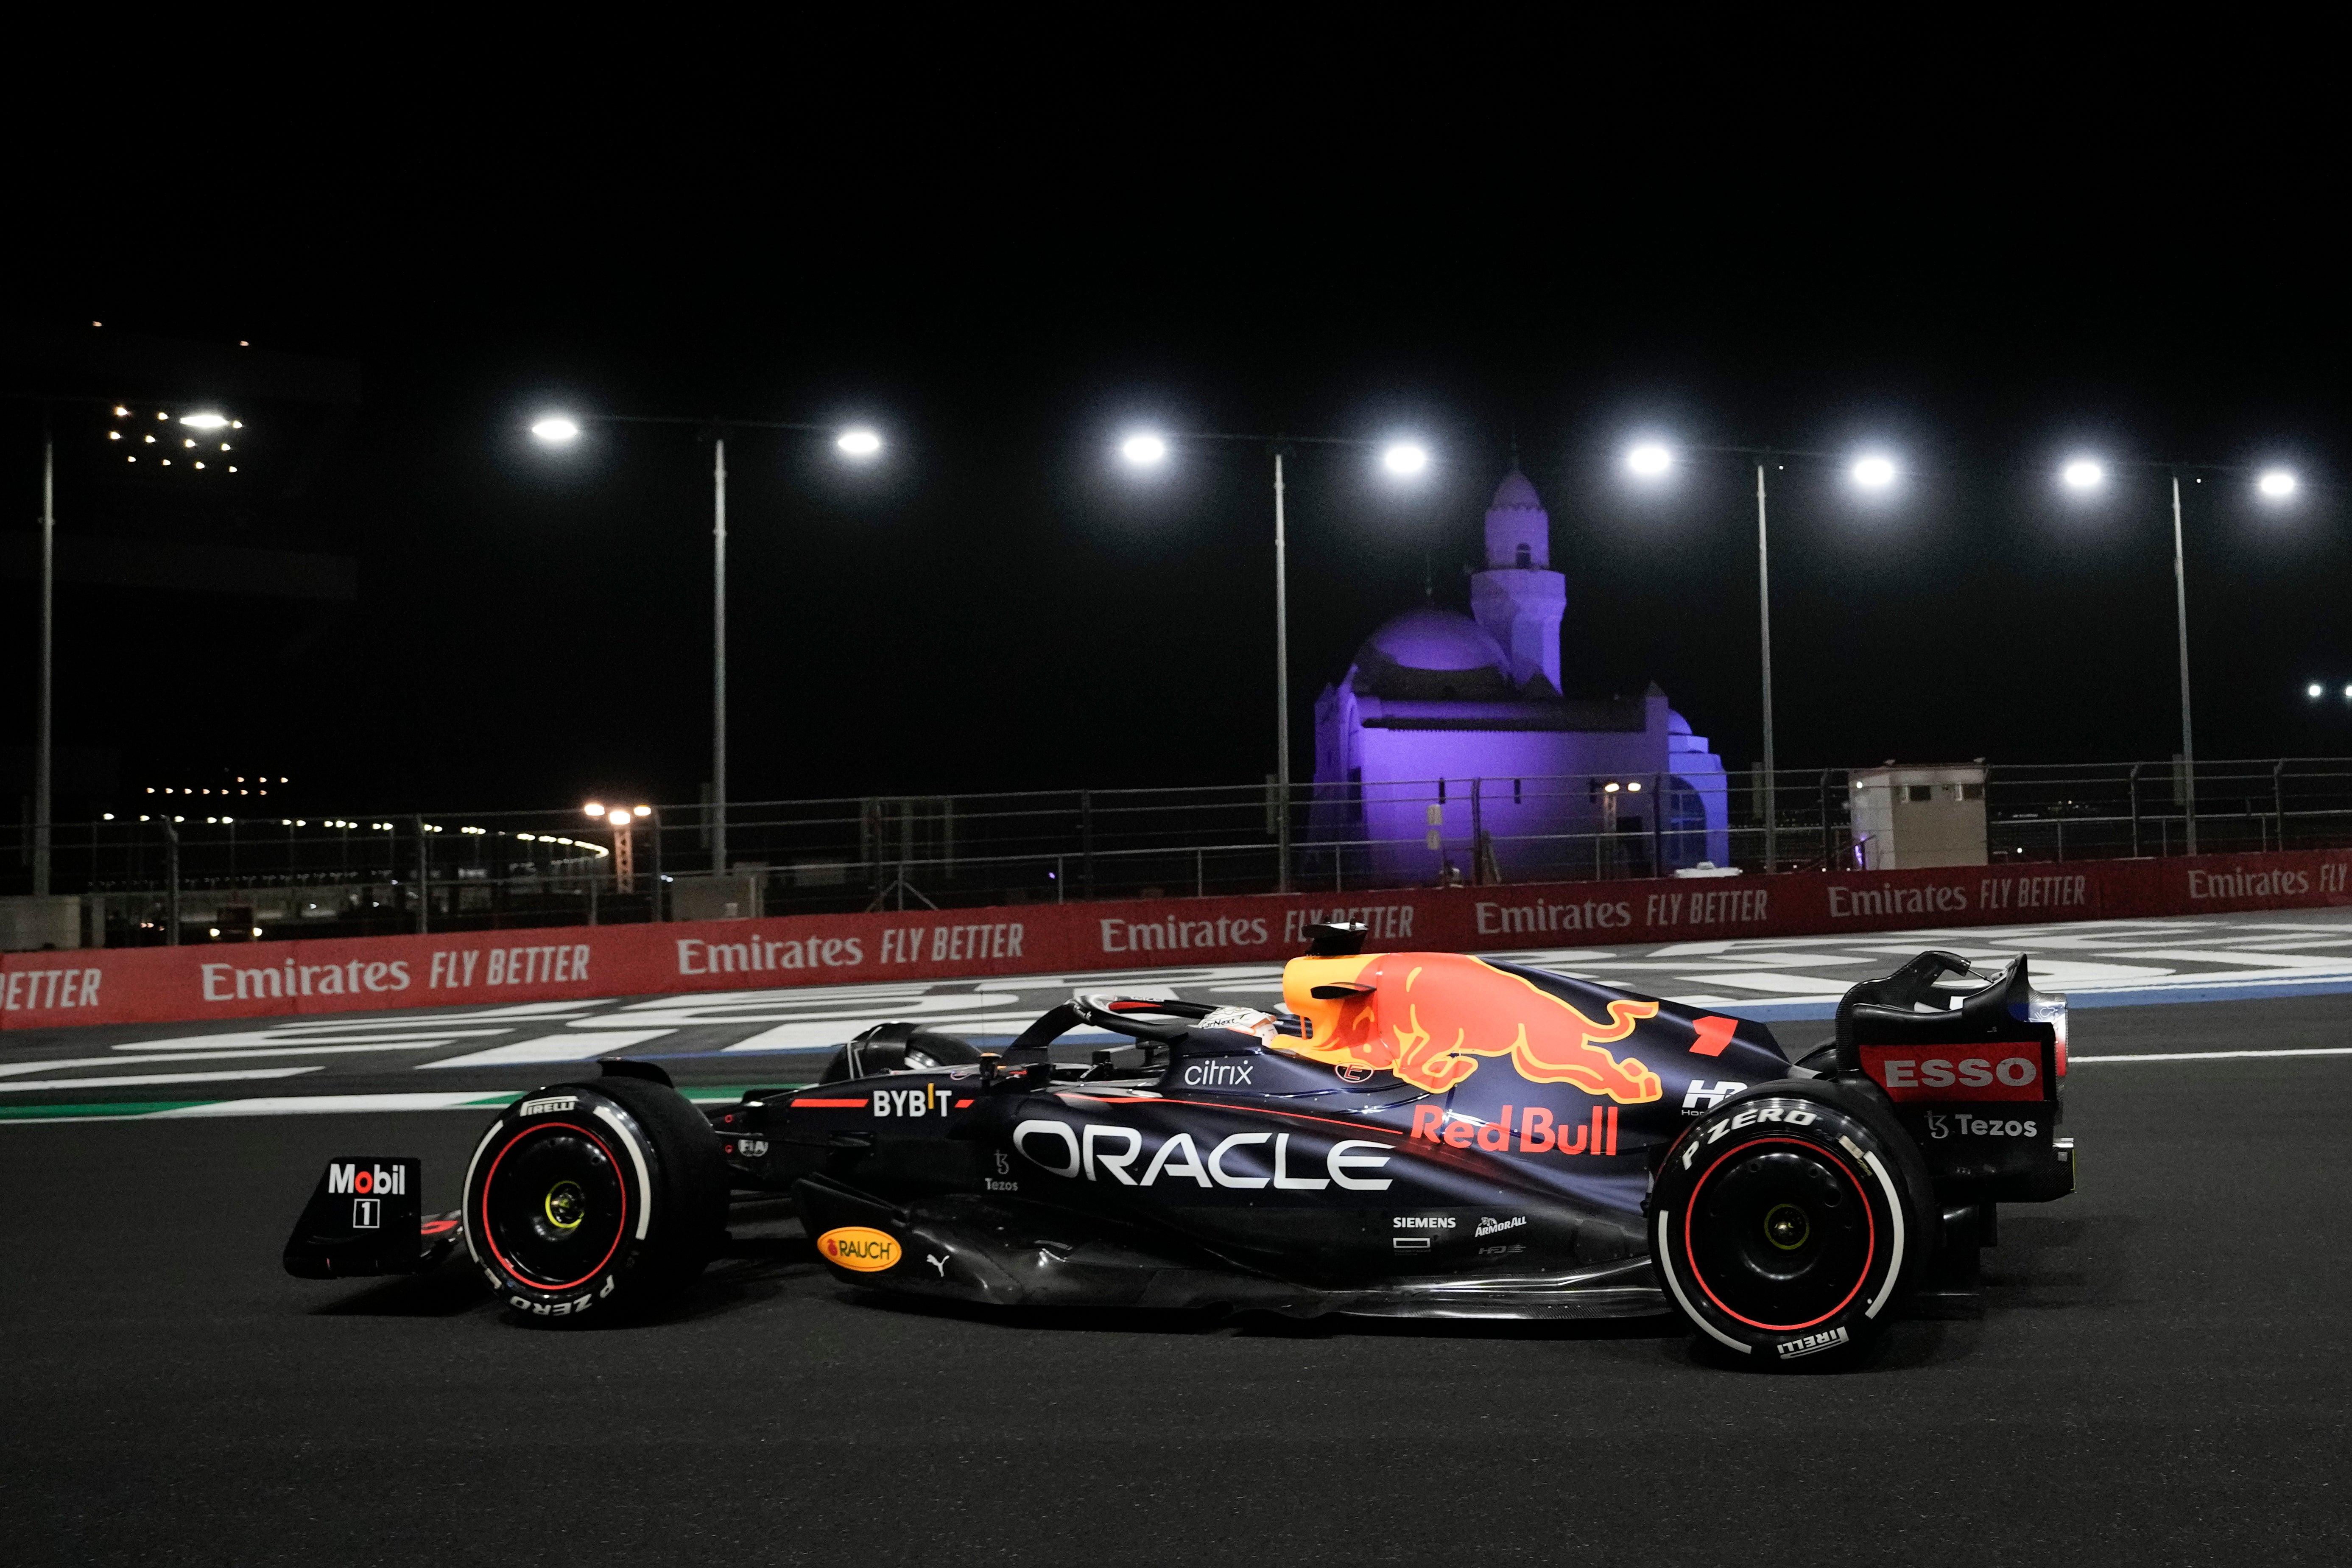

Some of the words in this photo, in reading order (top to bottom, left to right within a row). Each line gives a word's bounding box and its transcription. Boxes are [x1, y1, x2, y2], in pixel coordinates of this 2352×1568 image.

[1827, 882, 1967, 917] Emirates
[1980, 878, 2012, 909] FLY
[2018, 875, 2085, 907] BETTER
[2187, 867, 2309, 898] Emirates
[2319, 863, 2348, 892] FLY
[1475, 897, 1631, 934] Emirates
[1646, 893, 1682, 926] FLY
[1690, 889, 1768, 924] BETTER
[677, 934, 863, 975] Emirates
[881, 928, 925, 964] FLY
[931, 923, 1024, 961] BETTER
[1100, 914, 1268, 952] Emirates
[201, 958, 410, 1001] Emirates
[430, 950, 479, 989] FLY
[486, 944, 590, 985] BETTER
[0, 968, 102, 1011] ETTER
[1201, 1018, 1235, 1029] CarNext
[1184, 1060, 1254, 1085] citrix
[1884, 1057, 2036, 1087] ESSO
[519, 1095, 578, 1117] PIRELLI
[873, 1083, 952, 1117] BYBIT
[1409, 1104, 1513, 1152] Red
[1520, 1105, 1618, 1156] Bull
[1680, 1141, 1700, 1170] P
[1707, 1107, 1819, 1146] ZERO
[1955, 1114, 2037, 1138] Tezos
[1013, 1119, 1397, 1191] ORACLE
[328, 1163, 405, 1195] Mobil
[985, 1177, 1018, 1191] Tezos
[361, 1201, 371, 1226] 1
[1393, 1217, 1456, 1228] SIEMENS
[839, 1240, 891, 1259] RAUCH
[600, 1275, 614, 1299] P
[510, 1293, 592, 1315] ZERO
[1777, 1326, 1849, 1360] PIRELLI
